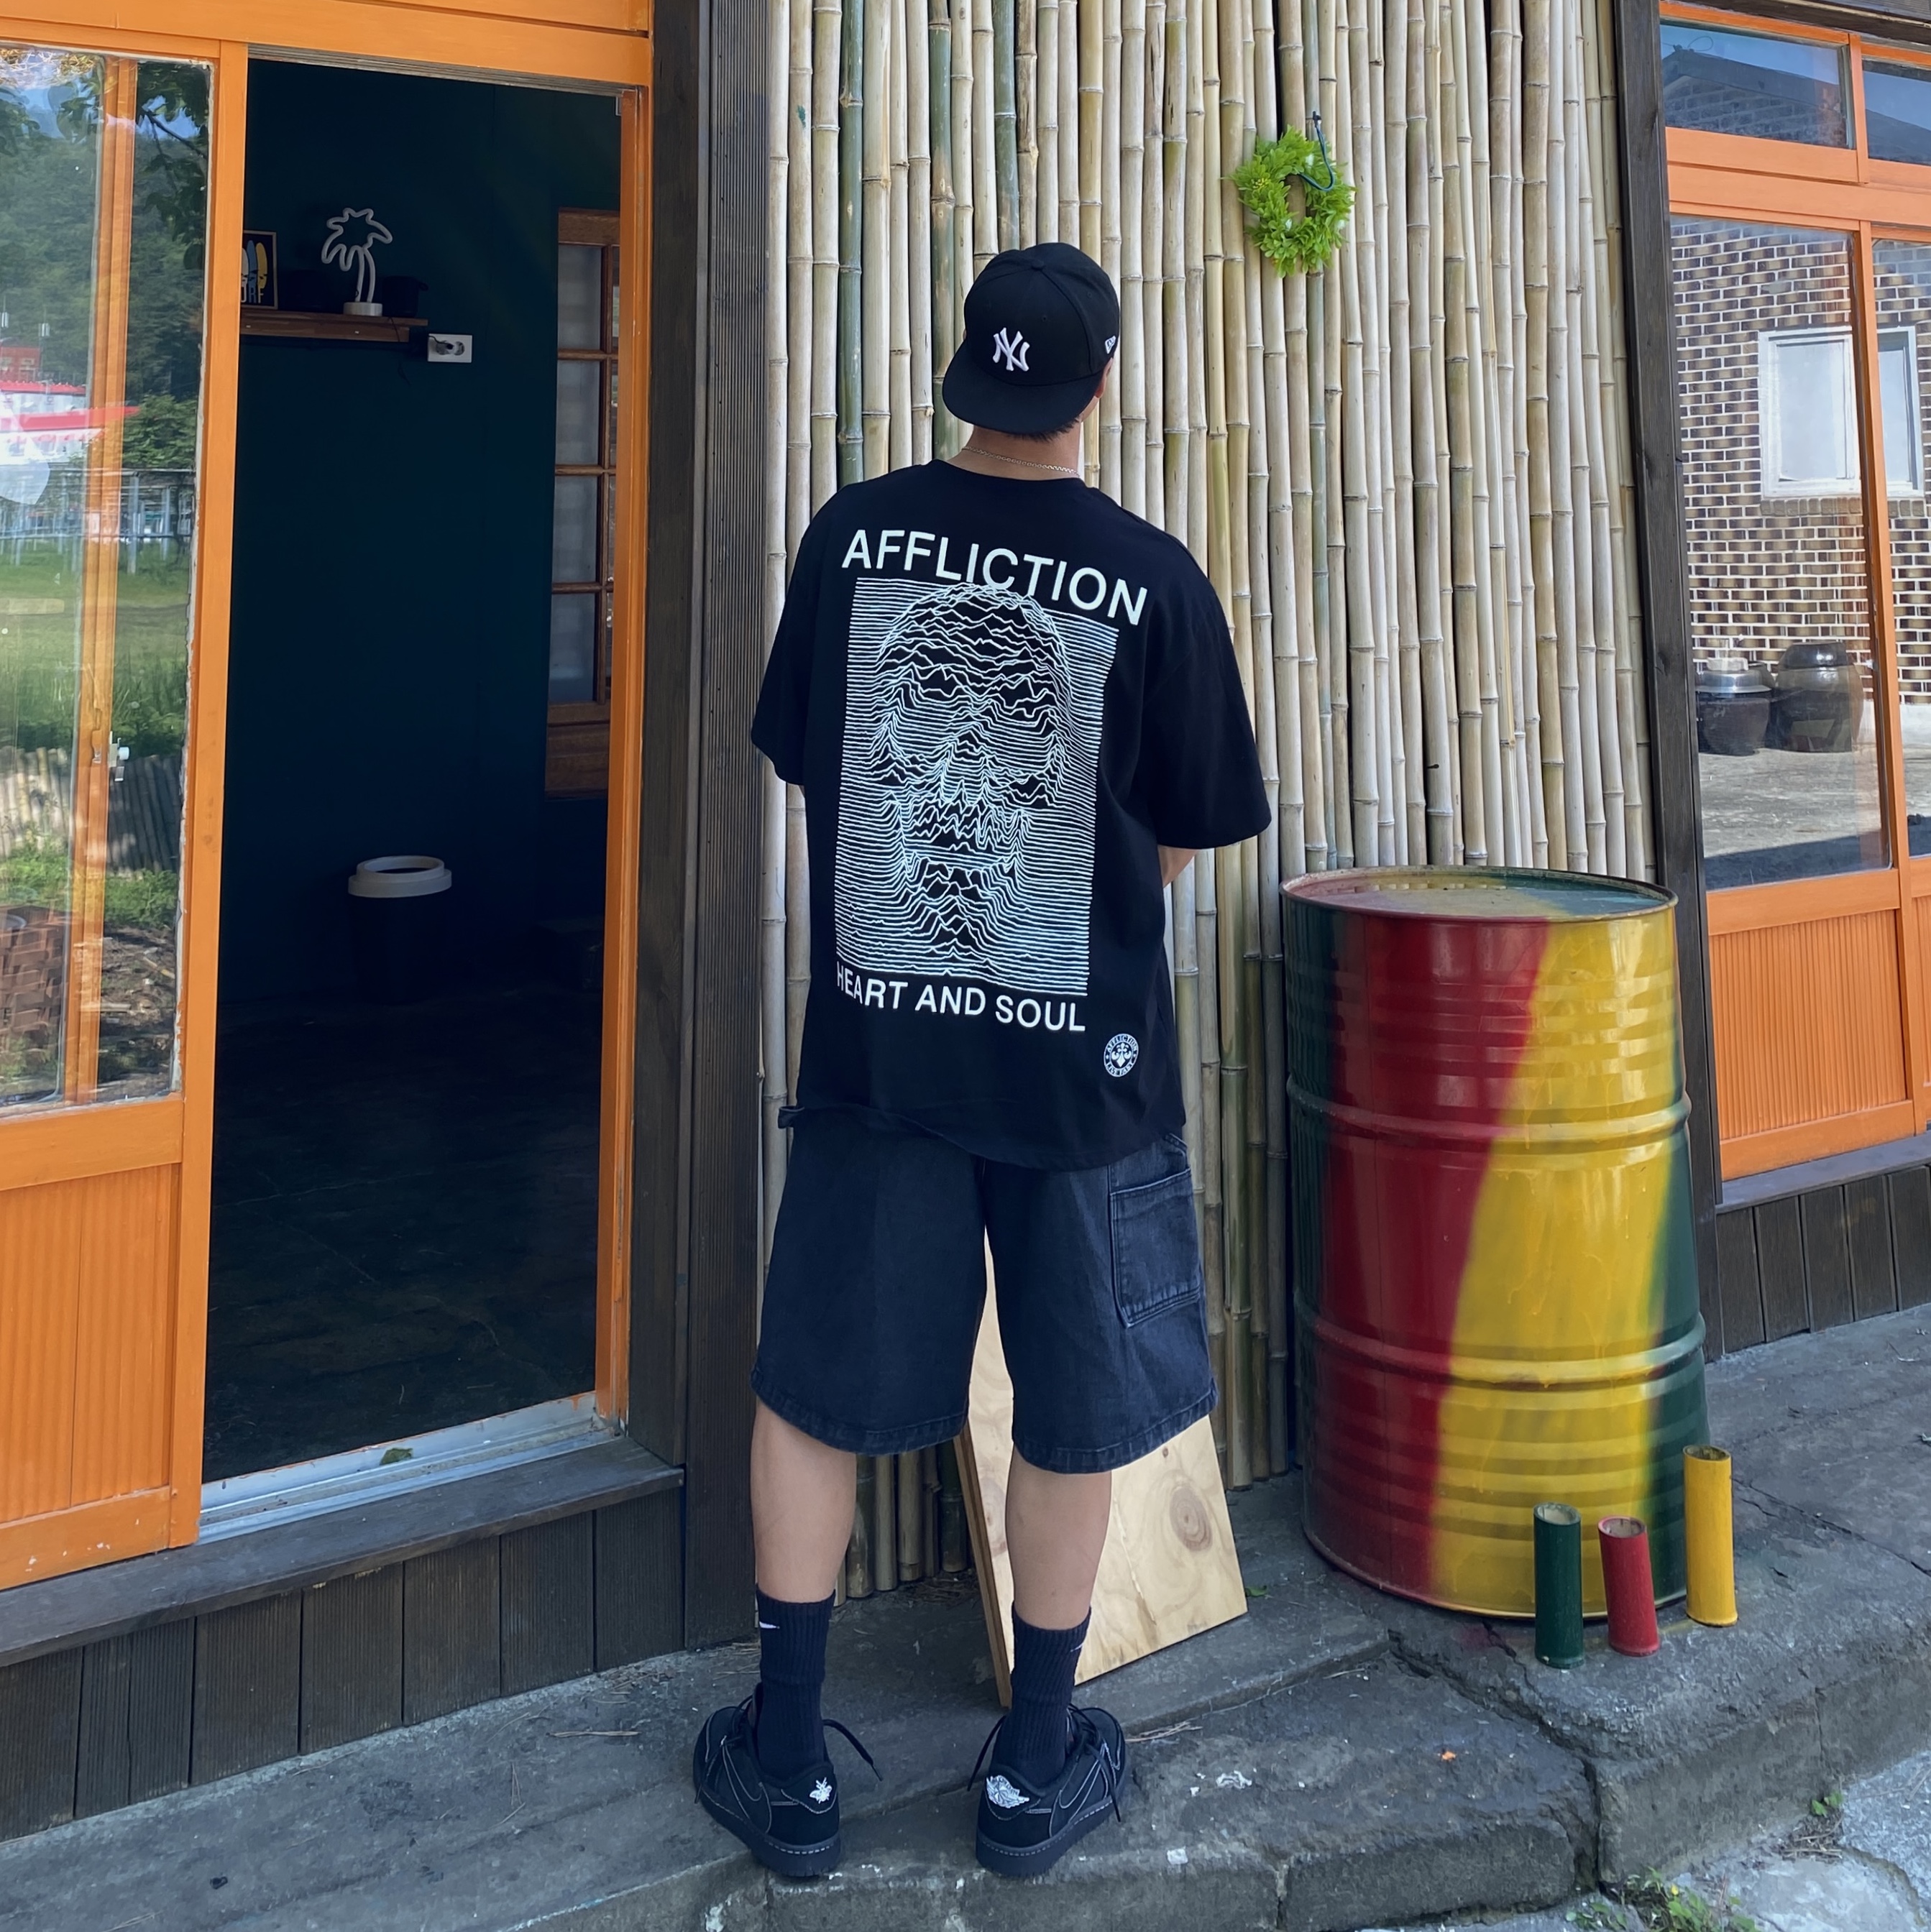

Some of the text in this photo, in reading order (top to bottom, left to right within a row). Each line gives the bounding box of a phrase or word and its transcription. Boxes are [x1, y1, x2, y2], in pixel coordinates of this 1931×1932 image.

[992, 327, 1030, 372] NY
[842, 529, 1147, 625] AFFLICTION
[836, 962, 1086, 1031] HEART AND SOUL
